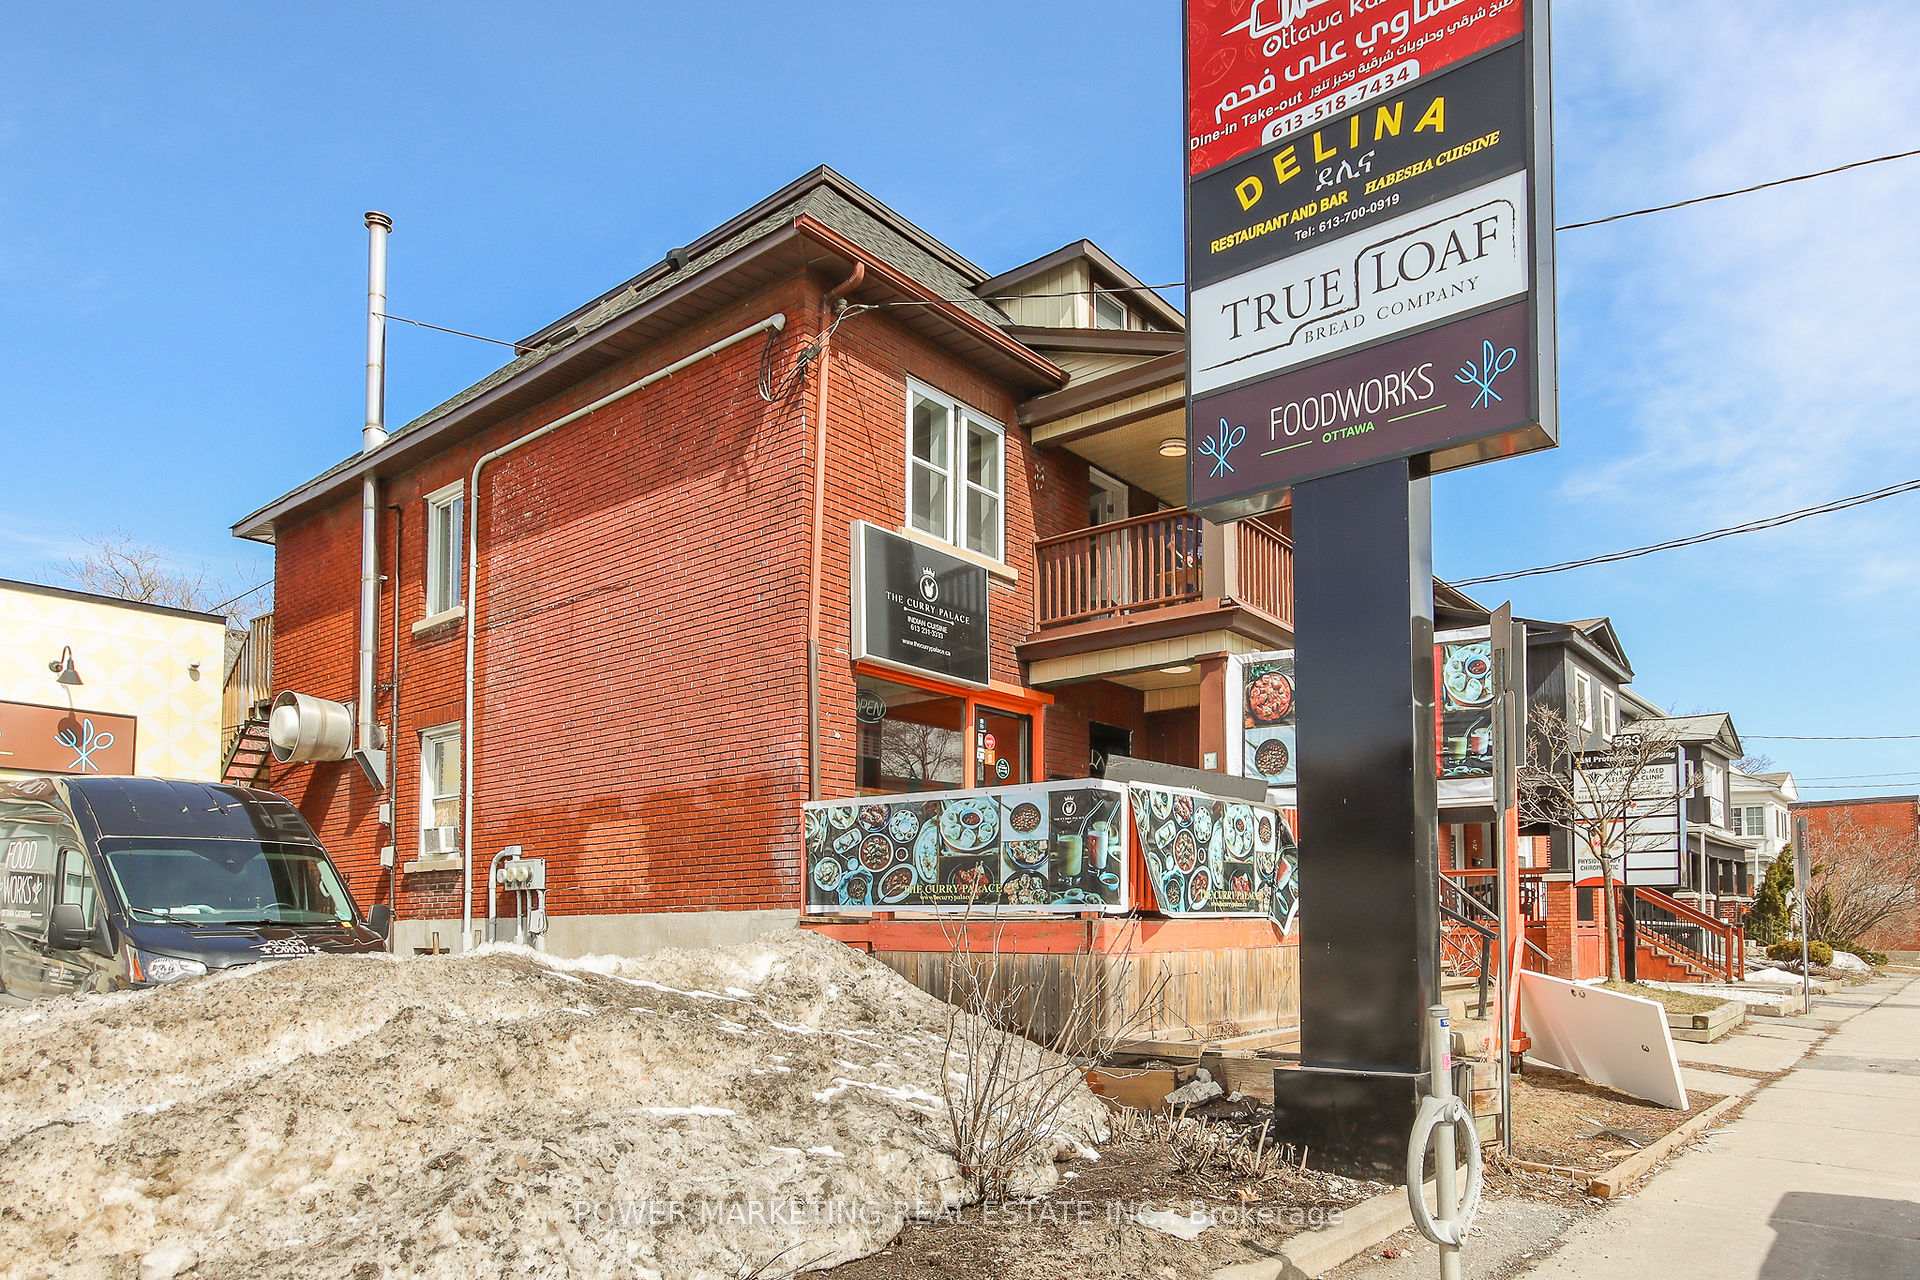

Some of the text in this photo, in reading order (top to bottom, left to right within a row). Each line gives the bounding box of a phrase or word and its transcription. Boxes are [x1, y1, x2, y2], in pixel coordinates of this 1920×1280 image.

[1262, 10, 1344, 57] Ottawa
[1285, 40, 1347, 81] على
[1214, 68, 1276, 124] فحم
[1190, 91, 1302, 150] Dine-in Take-out
[1234, 96, 1446, 211] DELINA
[1364, 131, 1500, 195] HABESHA CUISINE
[1210, 191, 1348, 254] RESTAURANT AND BAR
[1295, 194, 1400, 242] Tel: 613-700-0919
[1221, 215, 1500, 341] TRUE LOAF
[1304, 276, 1480, 344] BREAD COMPANY
[1269, 362, 1436, 441] FOODWORKS
[1322, 420, 1375, 444] OTTAWA
[885, 590, 970, 625] THE CURRY PALACE
[1614, 735, 1641, 747] 563
[6, 840, 38, 870] FOOD
[3, 875, 34, 905] WORKS
[924, 884, 958, 894] CURRY
